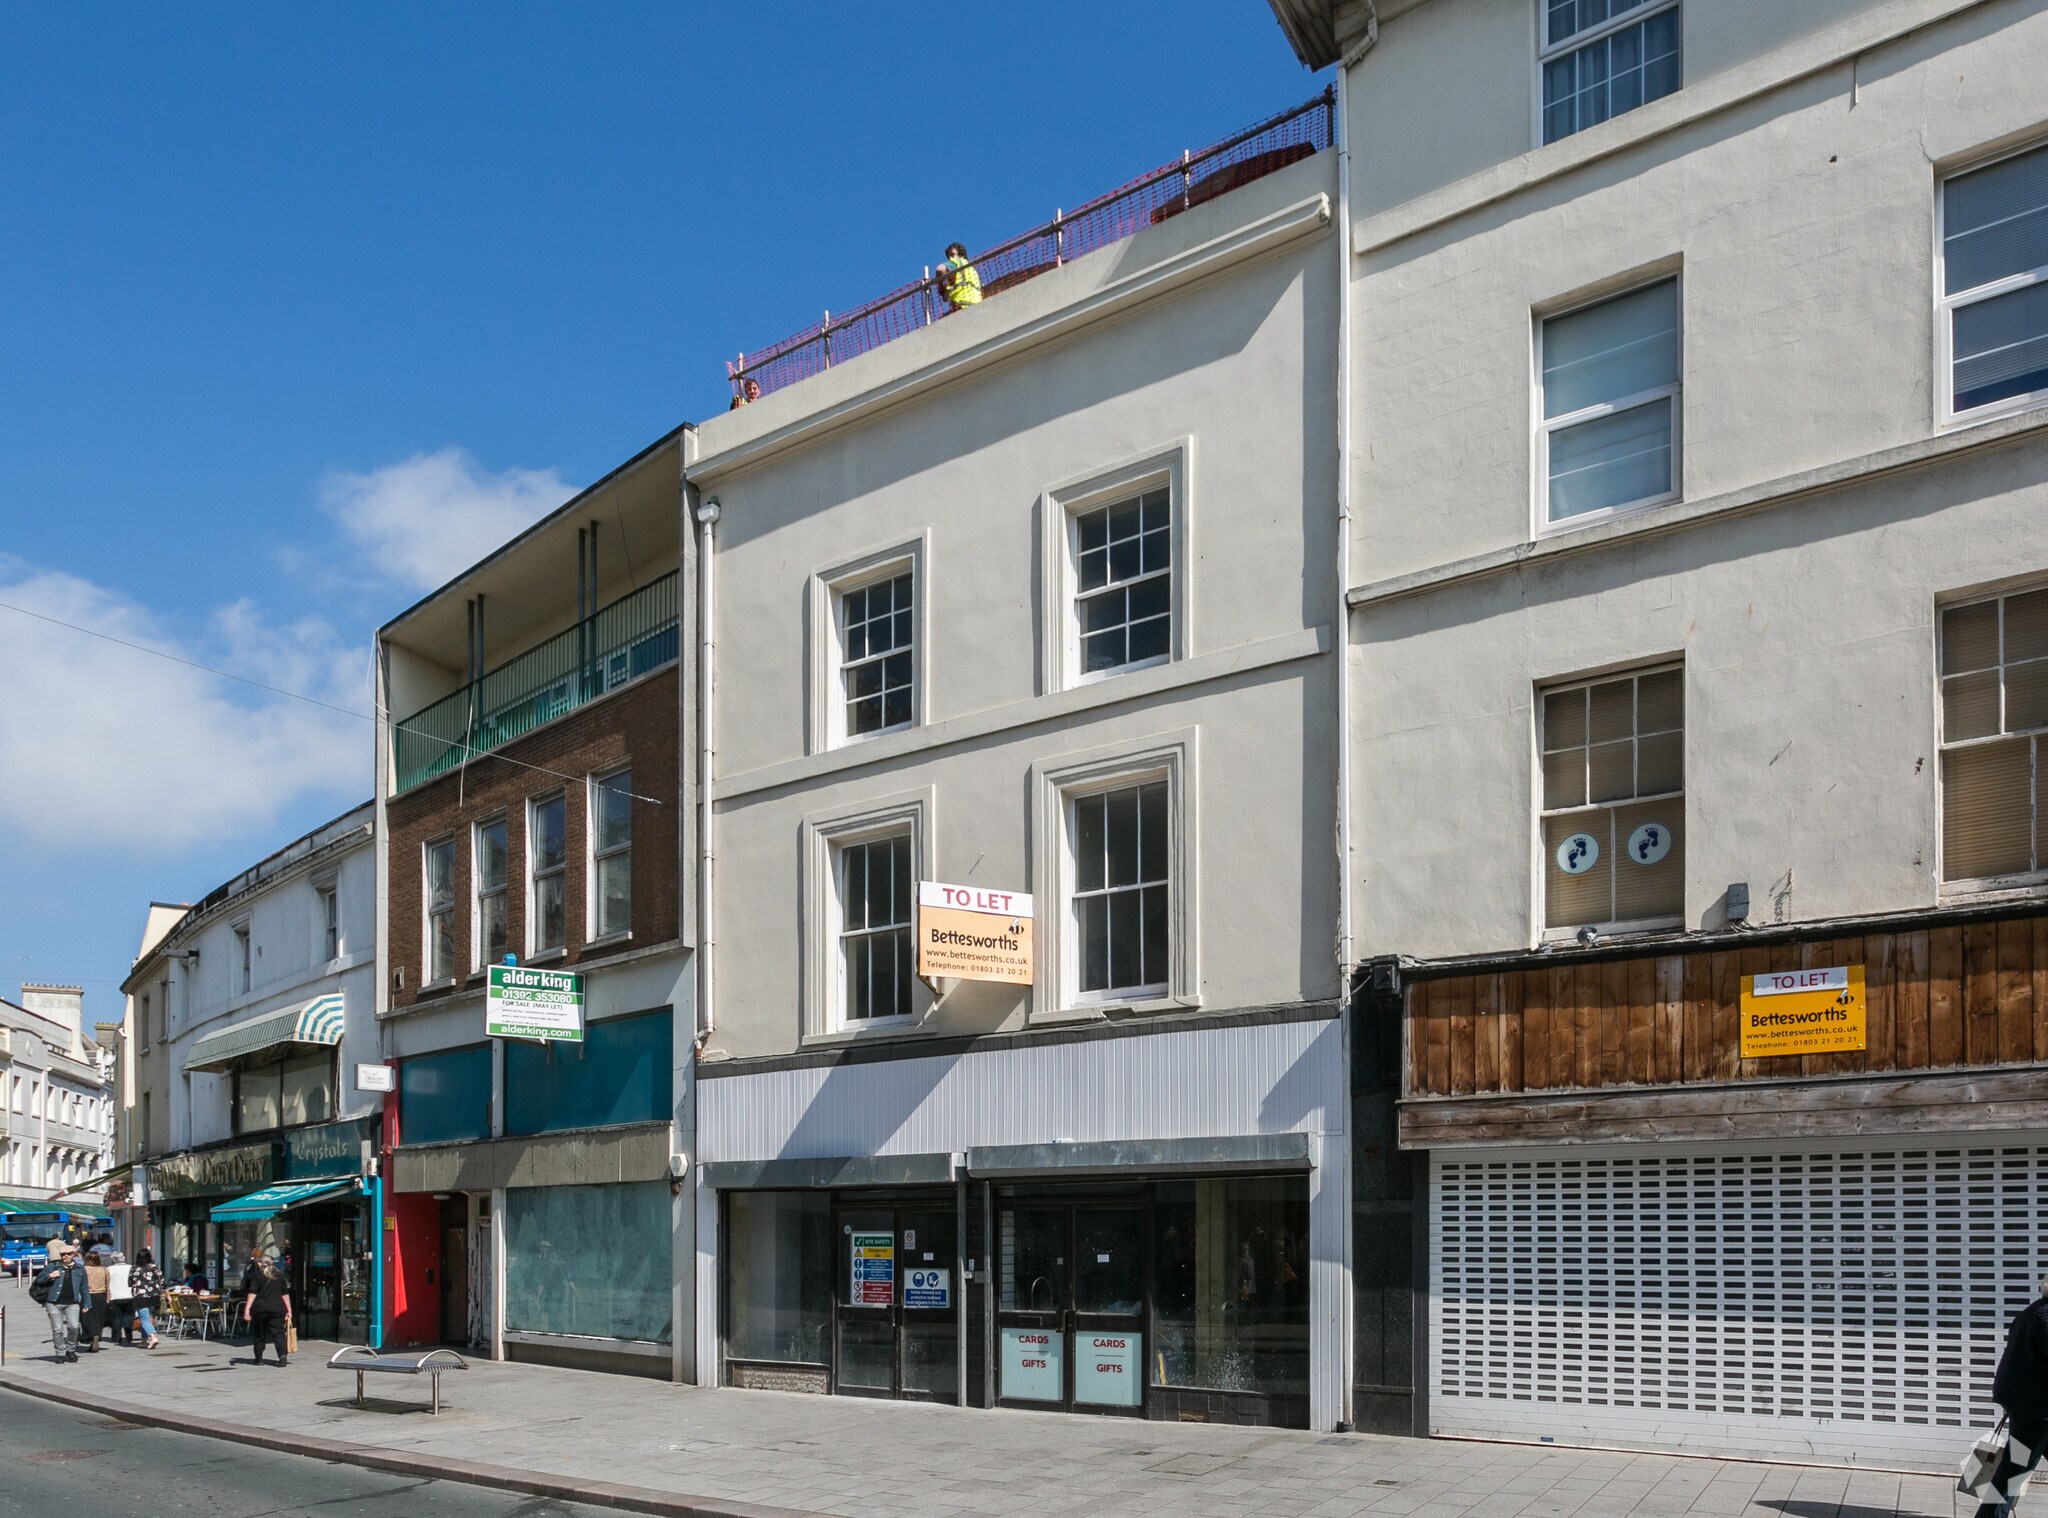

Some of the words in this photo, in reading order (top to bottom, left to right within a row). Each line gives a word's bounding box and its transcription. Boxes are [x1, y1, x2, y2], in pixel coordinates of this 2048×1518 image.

[942, 887, 971, 906] TO
[977, 892, 1013, 911] LET
[931, 928, 1019, 951] Bettesworths
[926, 949, 1028, 965] www.bettesworths.co.uk
[926, 960, 968, 971] Telephone:
[971, 964, 993, 974] 01803
[1771, 975, 1795, 990] TO
[1800, 972, 1830, 987] LET
[502, 989, 533, 1000] 01392
[534, 991, 573, 1003] 353080
[532, 1001, 549, 1010] (MAY
[550, 1003, 563, 1011] LET)
[1751, 1006, 1848, 1027] Bettesworths
[501, 1025, 572, 1038] alderking.com
[1746, 1025, 1858, 1040] www.bettesworths.co.uk
[1746, 1042, 1790, 1050] Telephone:
[1793, 1038, 1818, 1047] 01803
[296, 1137, 348, 1167] Crystals
[233, 1153, 265, 1183] OGGY
[1018, 1335, 1049, 1344] CARDS
[1093, 1338, 1126, 1348] CARDS
[1021, 1359, 1047, 1368] GIFTS
[1096, 1364, 1123, 1373] GIFTS
